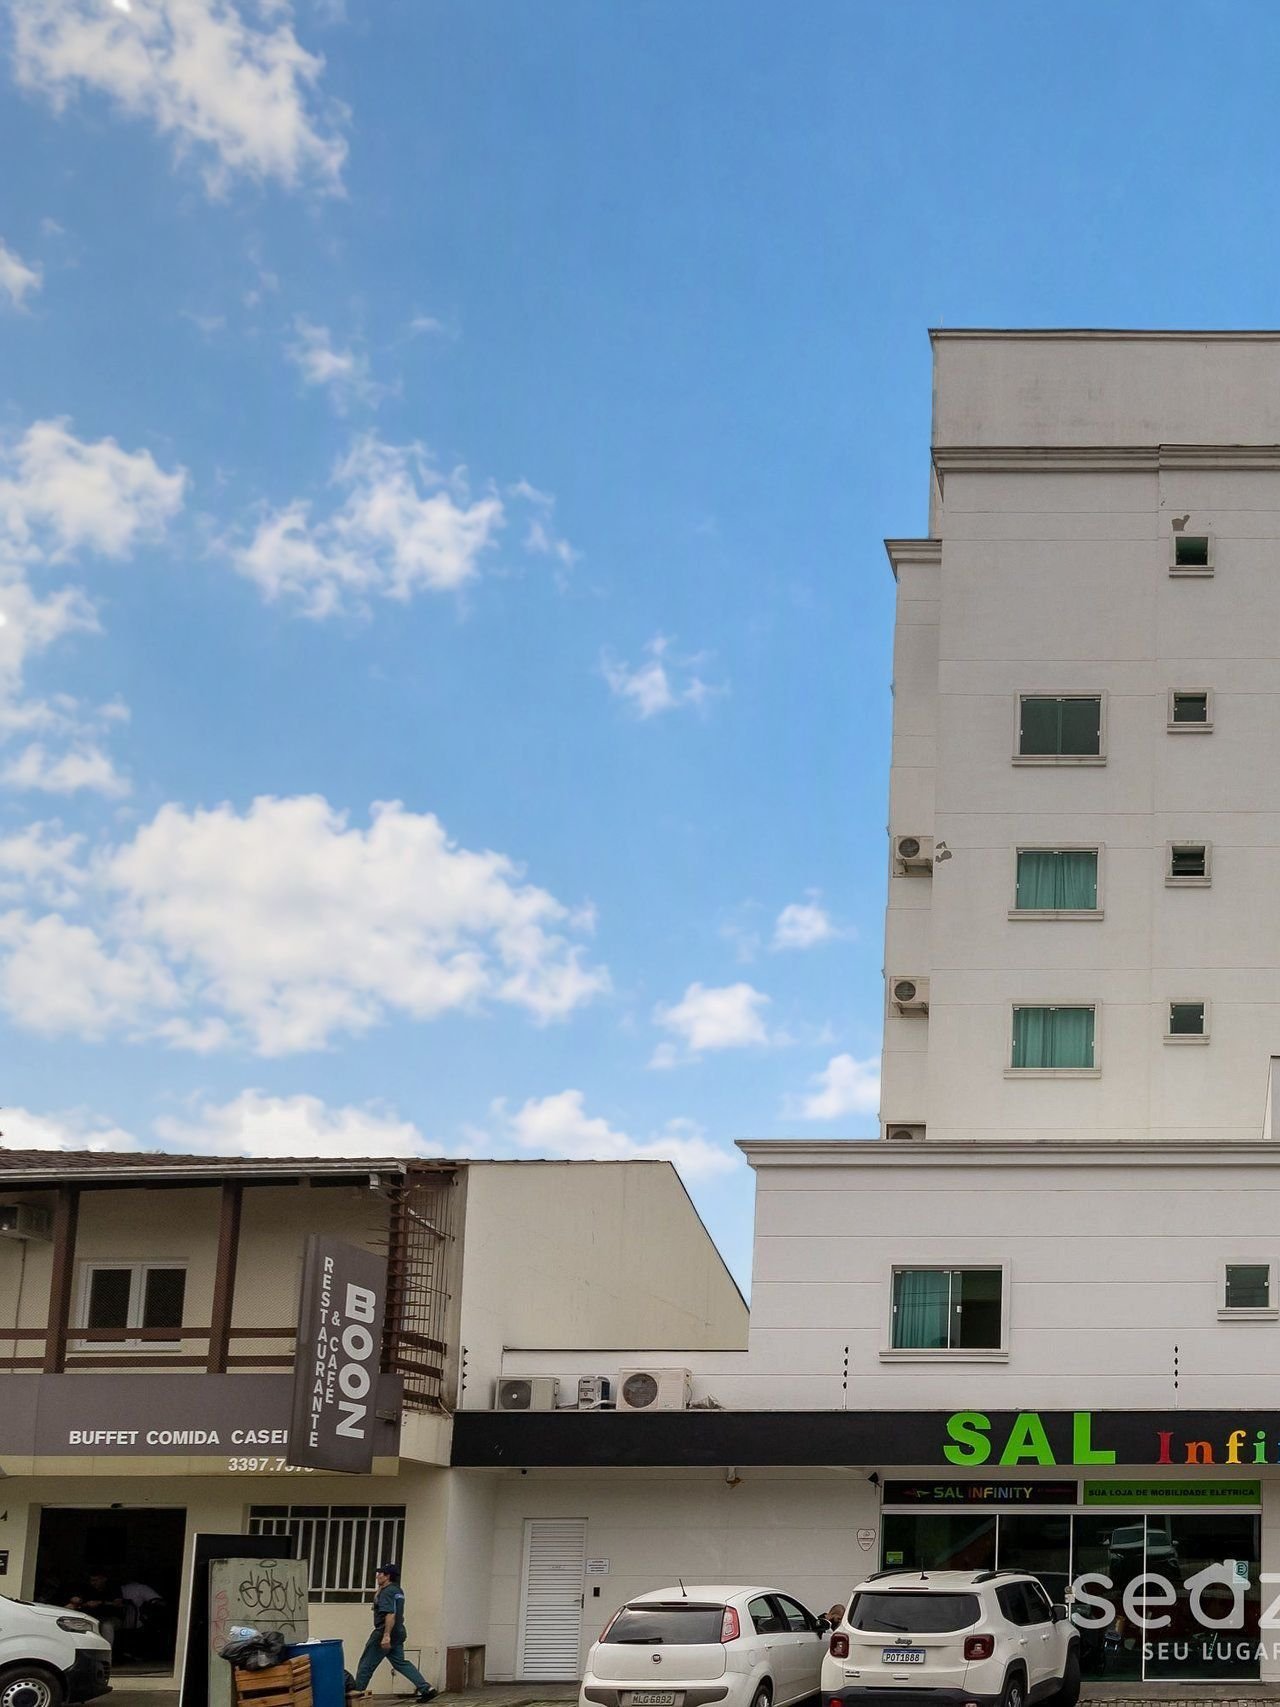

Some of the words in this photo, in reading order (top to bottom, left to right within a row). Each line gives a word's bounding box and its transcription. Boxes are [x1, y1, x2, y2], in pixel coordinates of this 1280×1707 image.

[331, 1310, 341, 1327] &
[309, 1256, 334, 1448] RESTAURANTE
[336, 1282, 376, 1439] BOOZ
[69, 1430, 139, 1445] BUFFET
[146, 1430, 220, 1445] COMIDA
[231, 1430, 288, 1444] CASEI
[943, 1412, 1117, 1466] SAL
[228, 1458, 314, 1472] 3397.7
[934, 1487, 964, 1498] SAL
[968, 1487, 1033, 1498] INFINITY
[1089, 1489, 1107, 1497] SUA
[1110, 1489, 1133, 1497] LOJA
[1136, 1489, 1148, 1497] DE
[1151, 1489, 1208, 1497] MOBILIDADE
